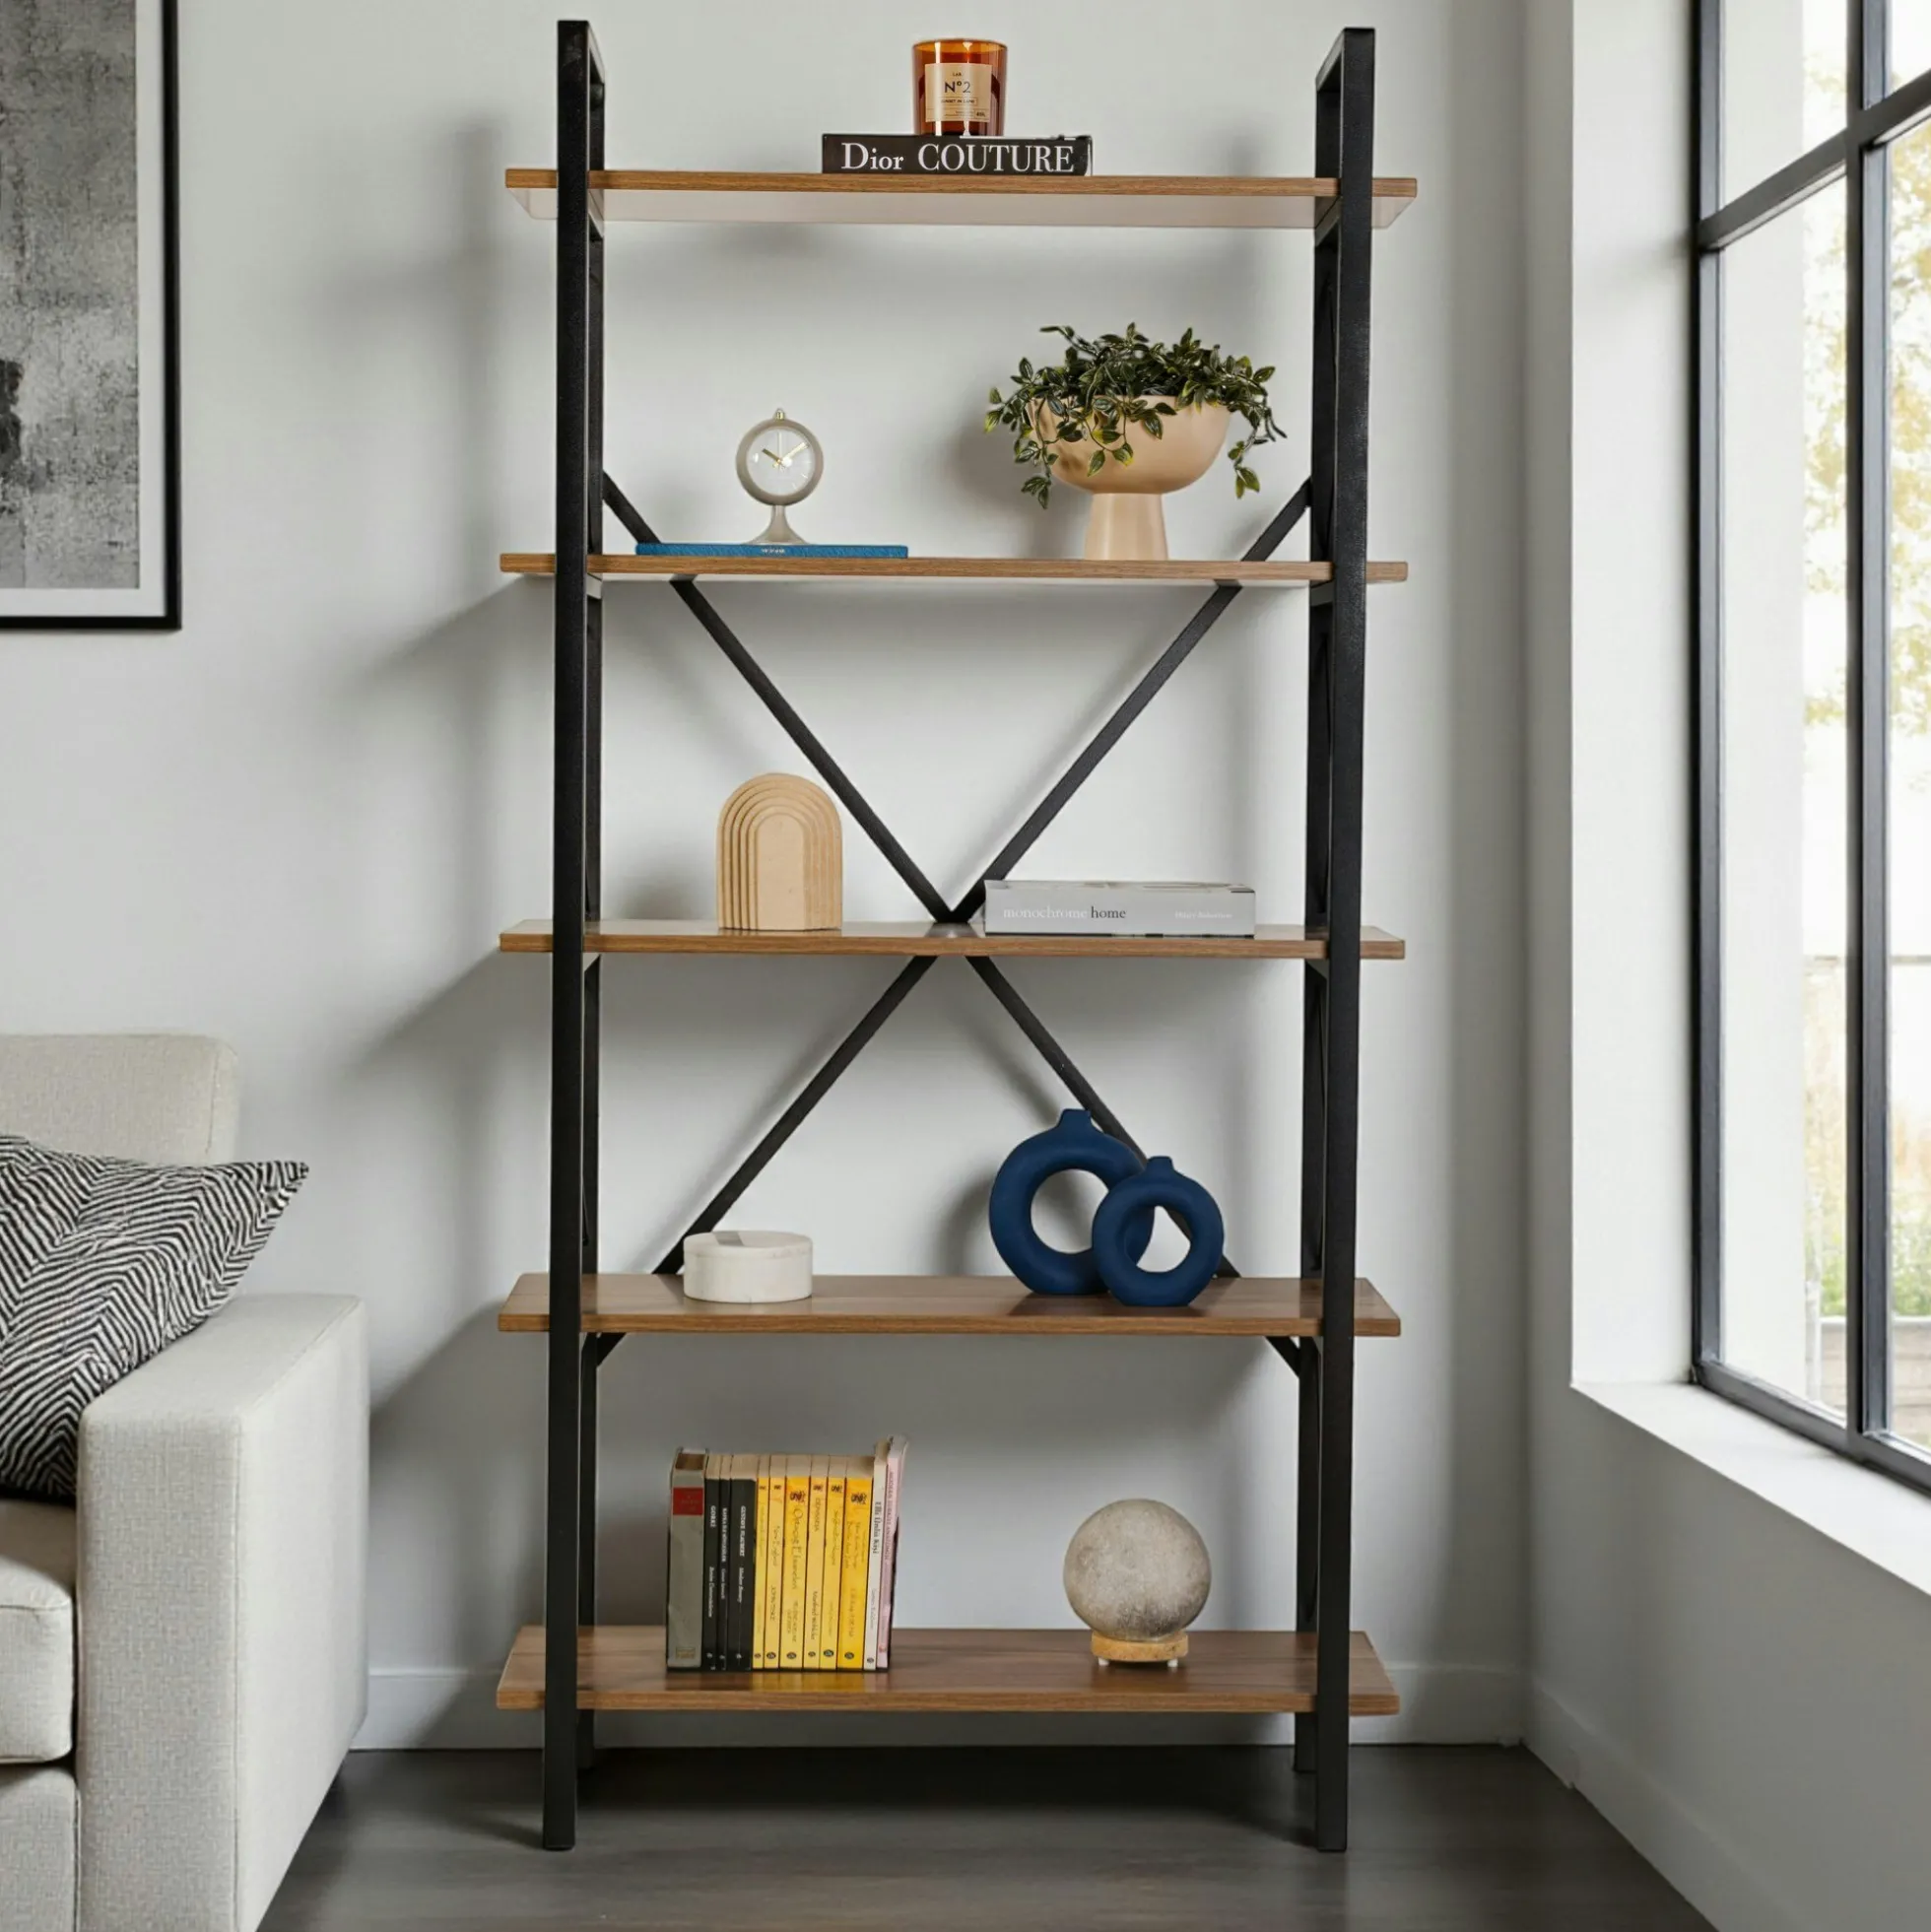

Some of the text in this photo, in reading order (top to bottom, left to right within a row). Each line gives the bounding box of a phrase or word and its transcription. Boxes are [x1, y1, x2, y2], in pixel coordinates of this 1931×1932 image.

[840, 142, 1074, 172] Dior COUTURE
[1003, 905, 1127, 919] monochrome home
